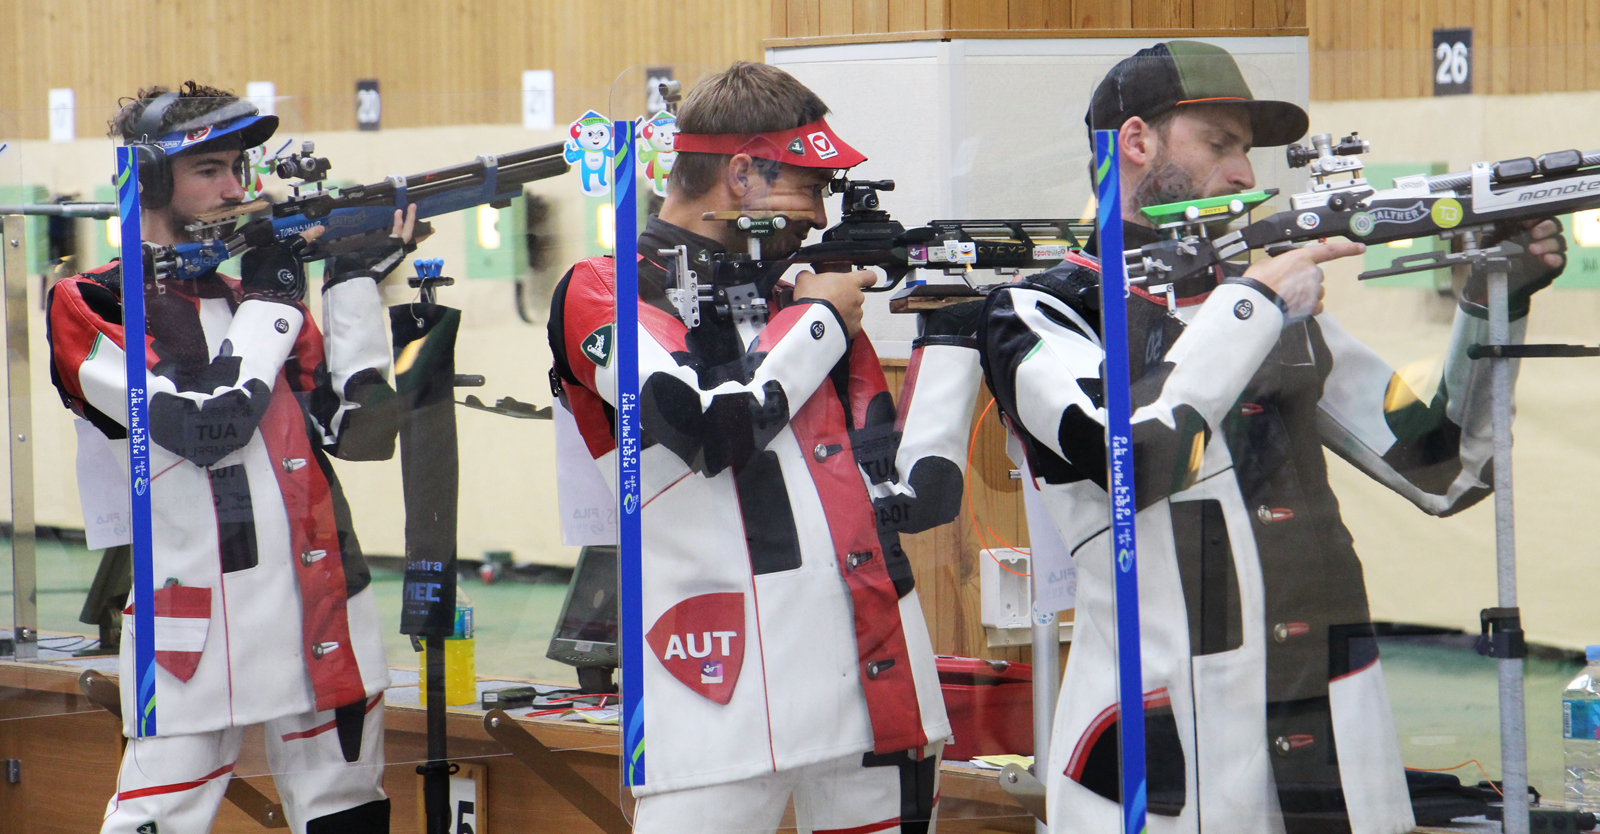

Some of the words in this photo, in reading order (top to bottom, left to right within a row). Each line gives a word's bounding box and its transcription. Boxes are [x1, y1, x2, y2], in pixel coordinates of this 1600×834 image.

[1436, 41, 1468, 84] 26
[130, 388, 146, 455] 창원국제사격장
[622, 393, 637, 467] 창원국제사격장
[1111, 435, 1132, 520] 창원국제사격장
[664, 631, 738, 660] AUT
